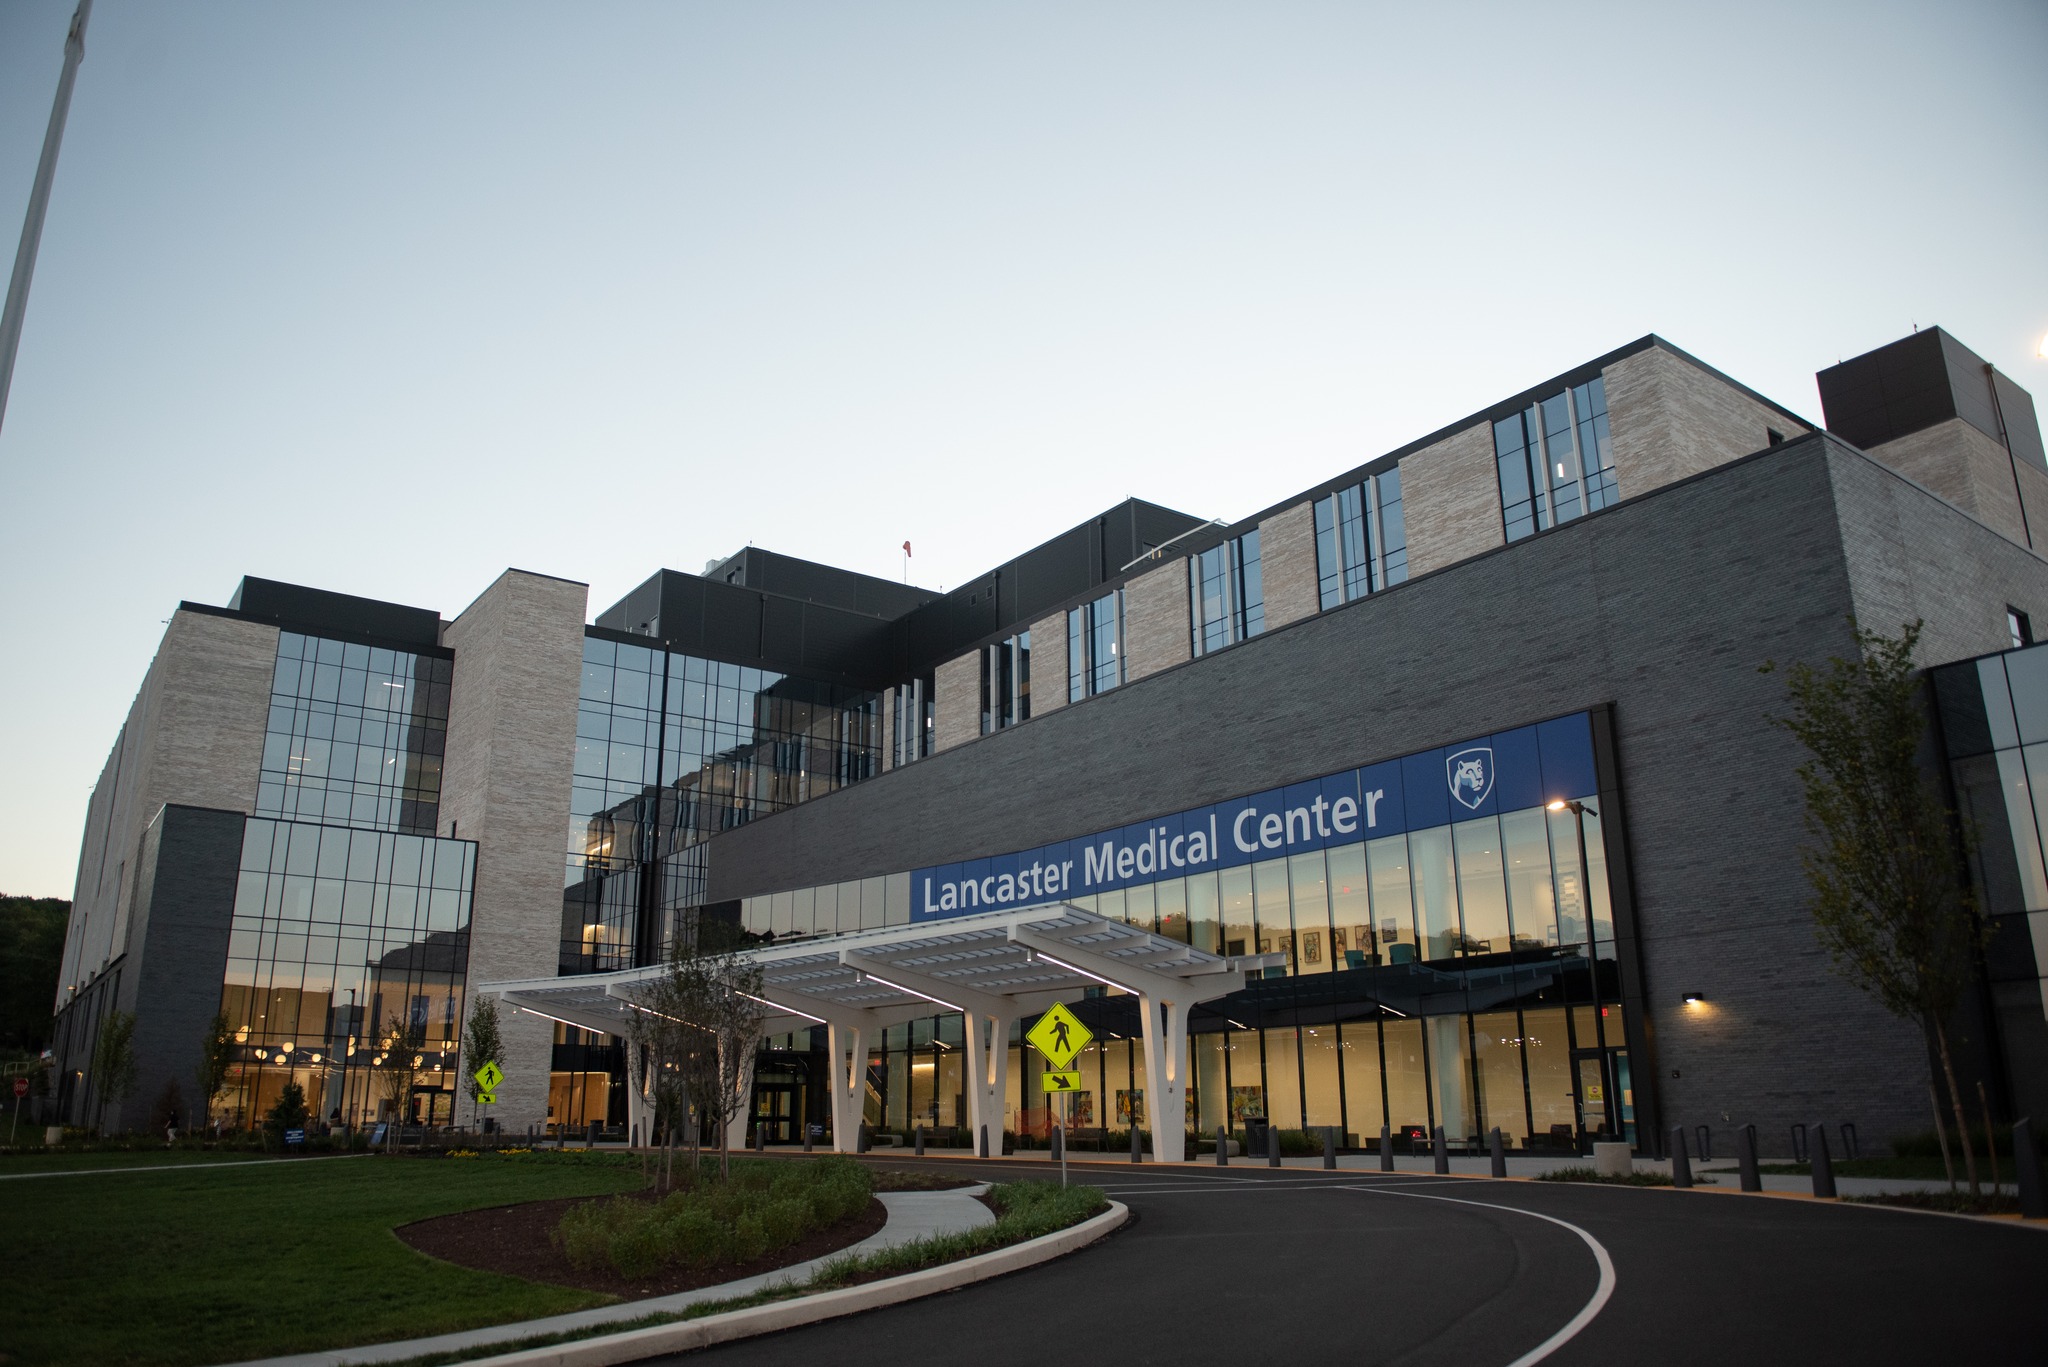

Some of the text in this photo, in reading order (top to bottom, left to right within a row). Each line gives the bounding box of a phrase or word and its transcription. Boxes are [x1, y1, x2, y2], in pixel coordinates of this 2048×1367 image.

[924, 788, 1383, 913] Lancaster Medical Center
